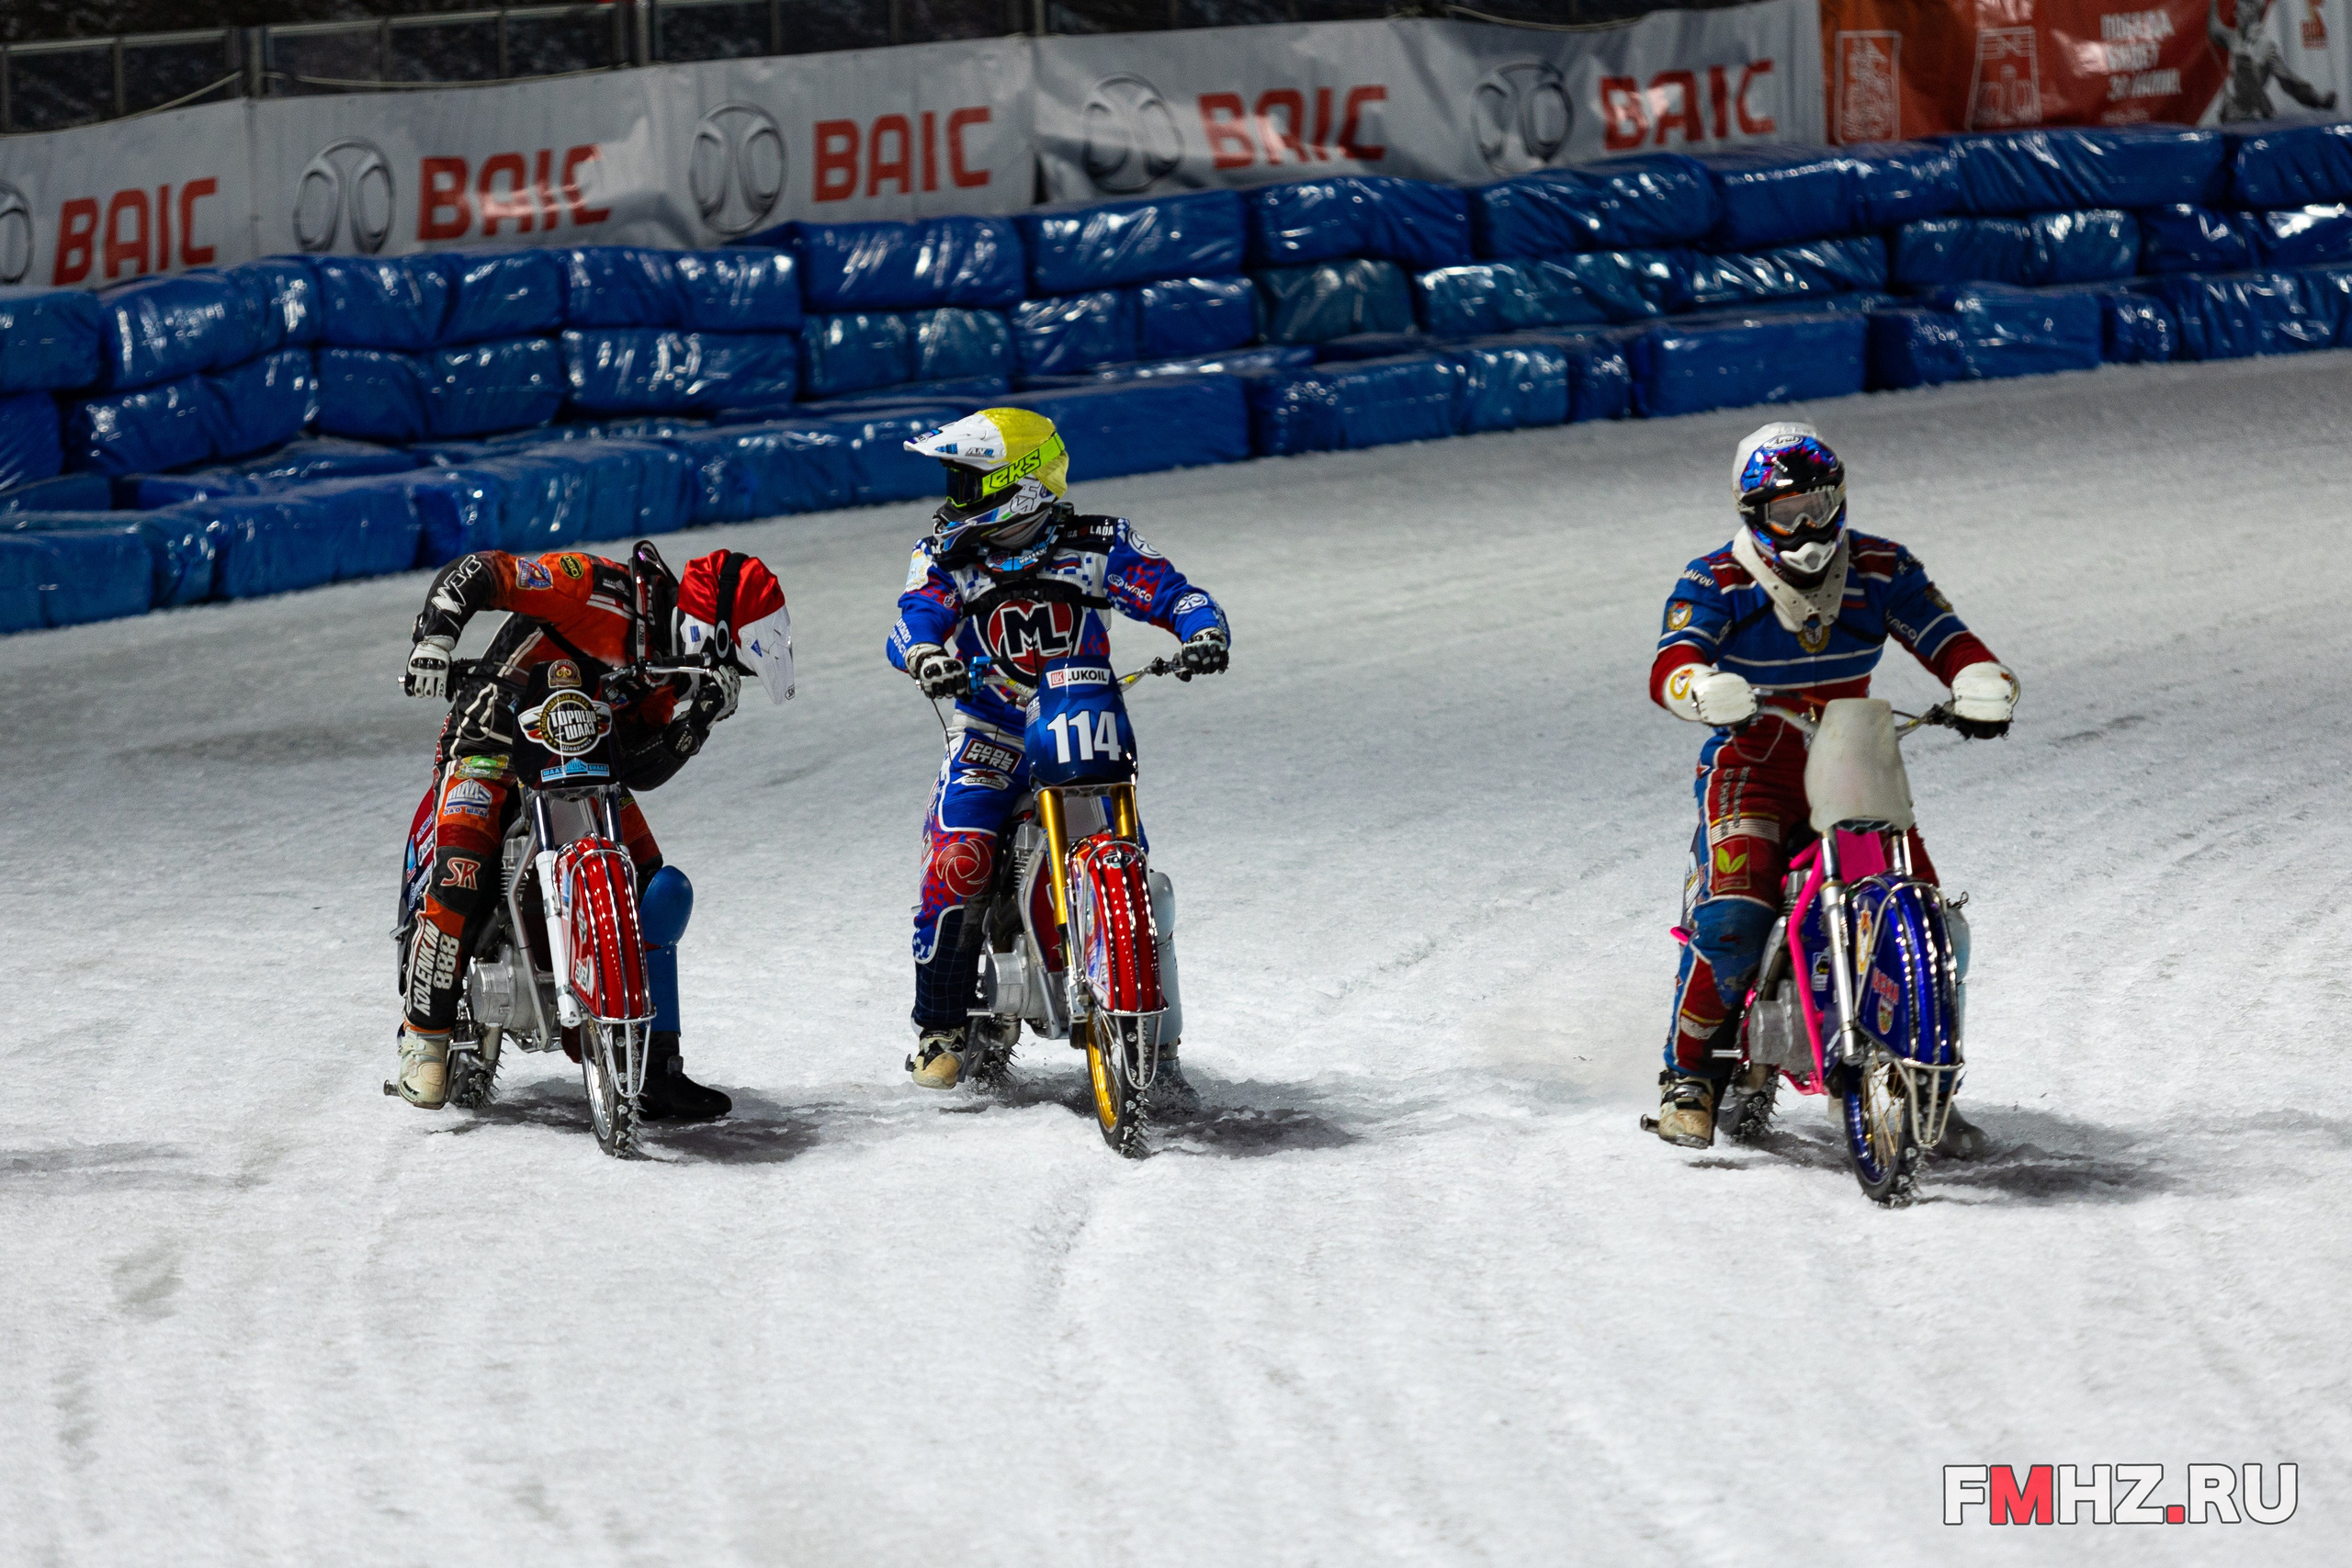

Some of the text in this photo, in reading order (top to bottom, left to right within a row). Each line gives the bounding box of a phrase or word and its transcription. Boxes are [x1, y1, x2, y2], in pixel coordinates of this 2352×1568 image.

[1200, 85, 1387, 169] BAIC
[1599, 59, 1776, 151] BAIC
[812, 106, 991, 203] BAIC
[416, 143, 613, 242] BAIC
[51, 176, 218, 287] BAIC
[1090, 525, 1114, 536] LADA
[1124, 581, 1153, 603] WACO
[1068, 670, 1108, 682] UKOIL
[548, 709, 597, 728] ТОРПЕДО
[1046, 710, 1122, 764] 114
[966, 751, 1012, 772] MTRS
[970, 741, 1014, 763] COOL
[440, 857, 481, 890] SR
[413, 919, 440, 1017] KOLENKIN
[433, 933, 459, 990] 888
